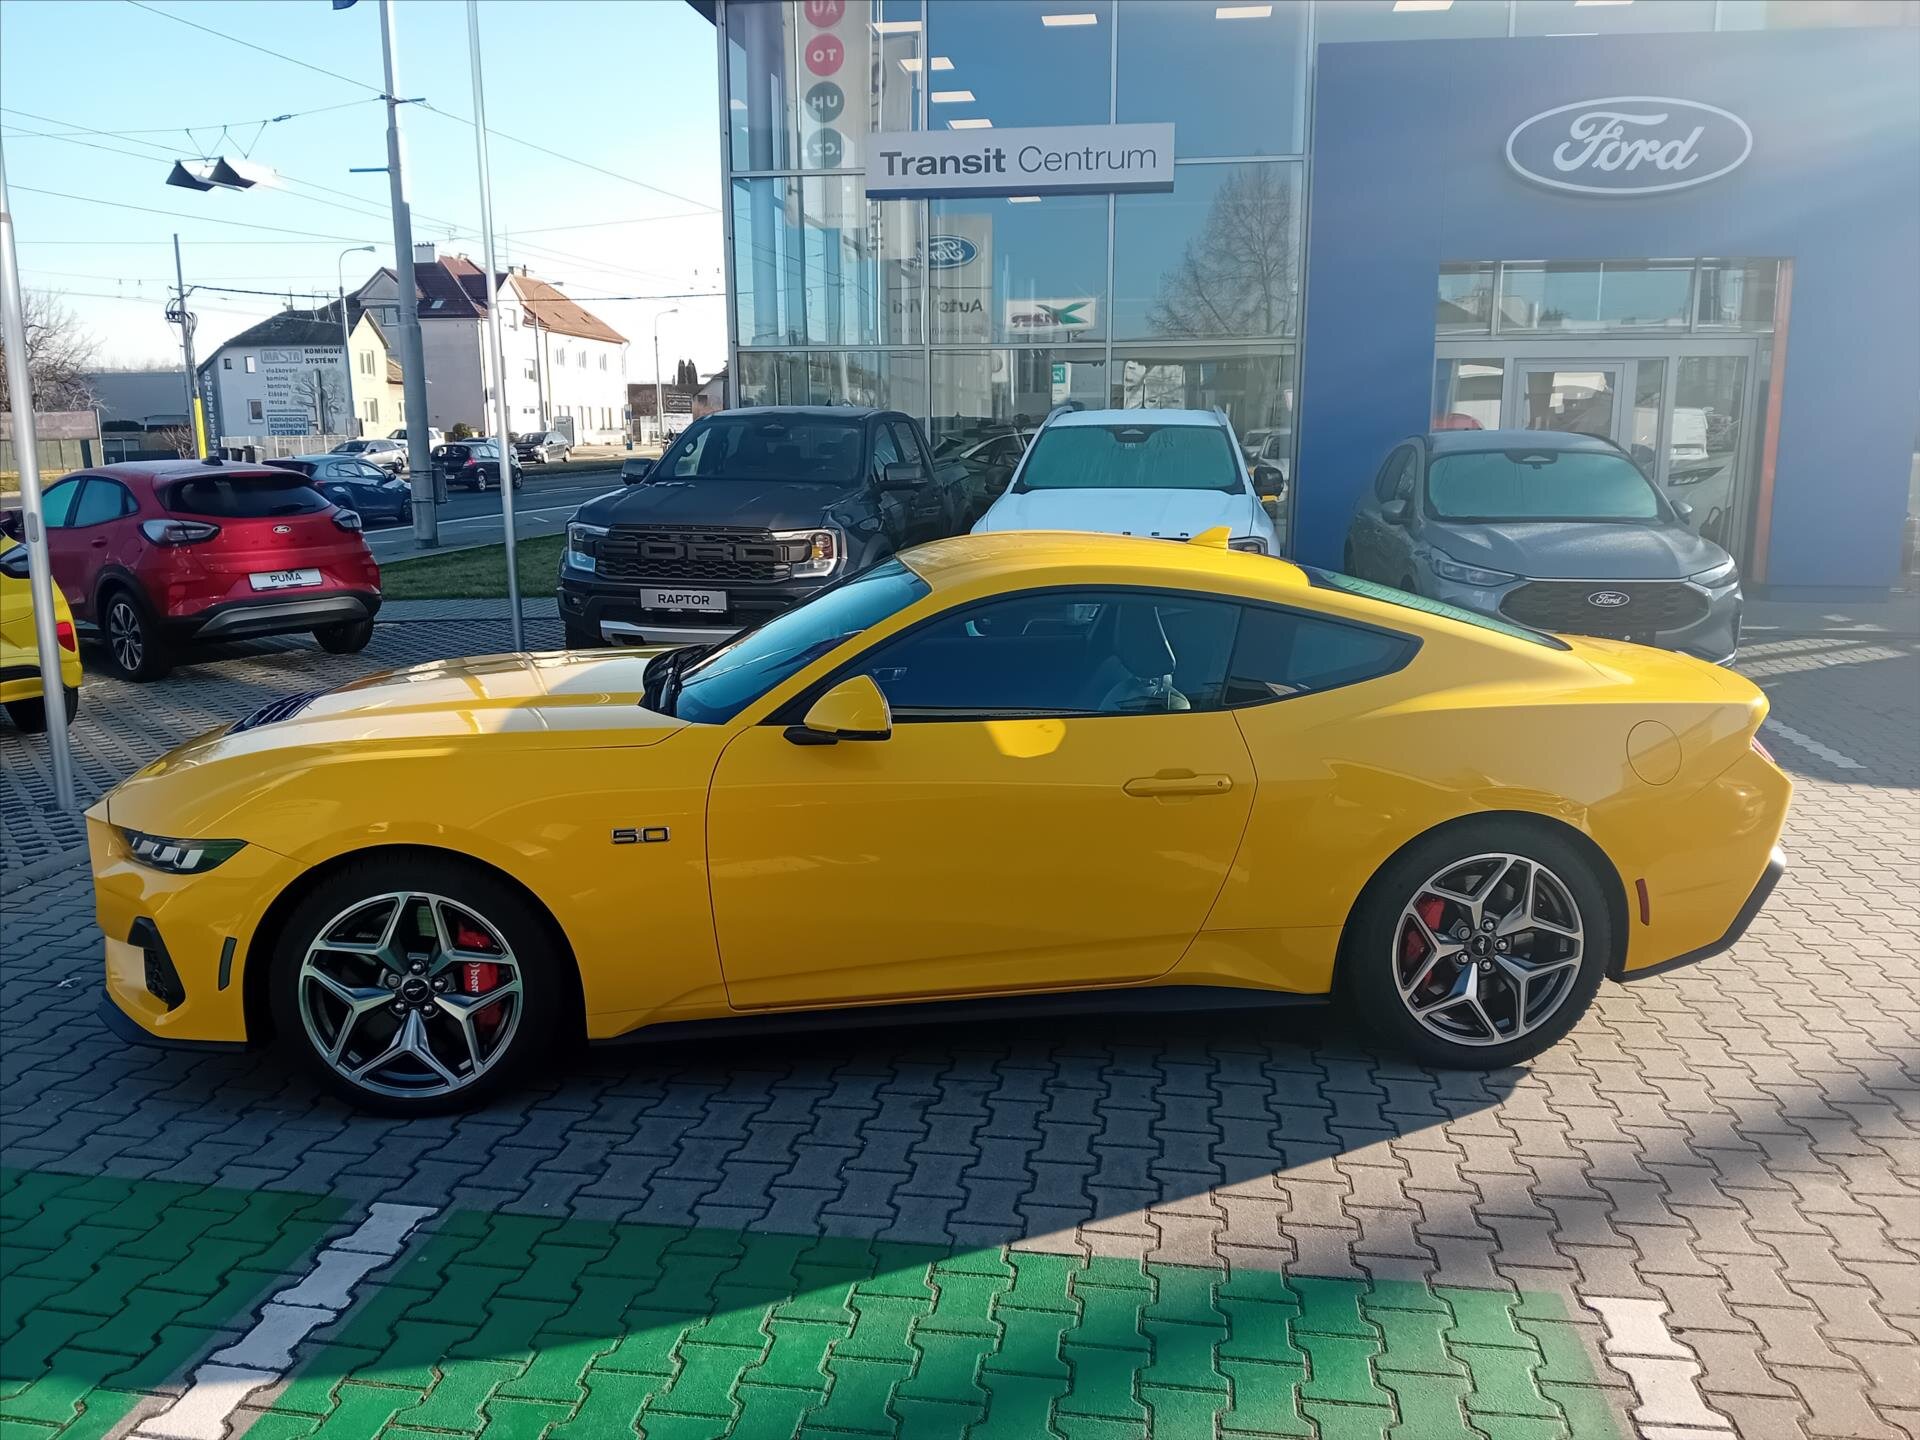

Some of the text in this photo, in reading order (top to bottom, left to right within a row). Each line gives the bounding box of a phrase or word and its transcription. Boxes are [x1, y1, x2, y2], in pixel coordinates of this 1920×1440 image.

[1553, 112, 1705, 171] Ford
[880, 145, 1157, 176] Transit Centrum
[269, 573, 302, 583] PUMA
[657, 593, 710, 605] RAPTOR
